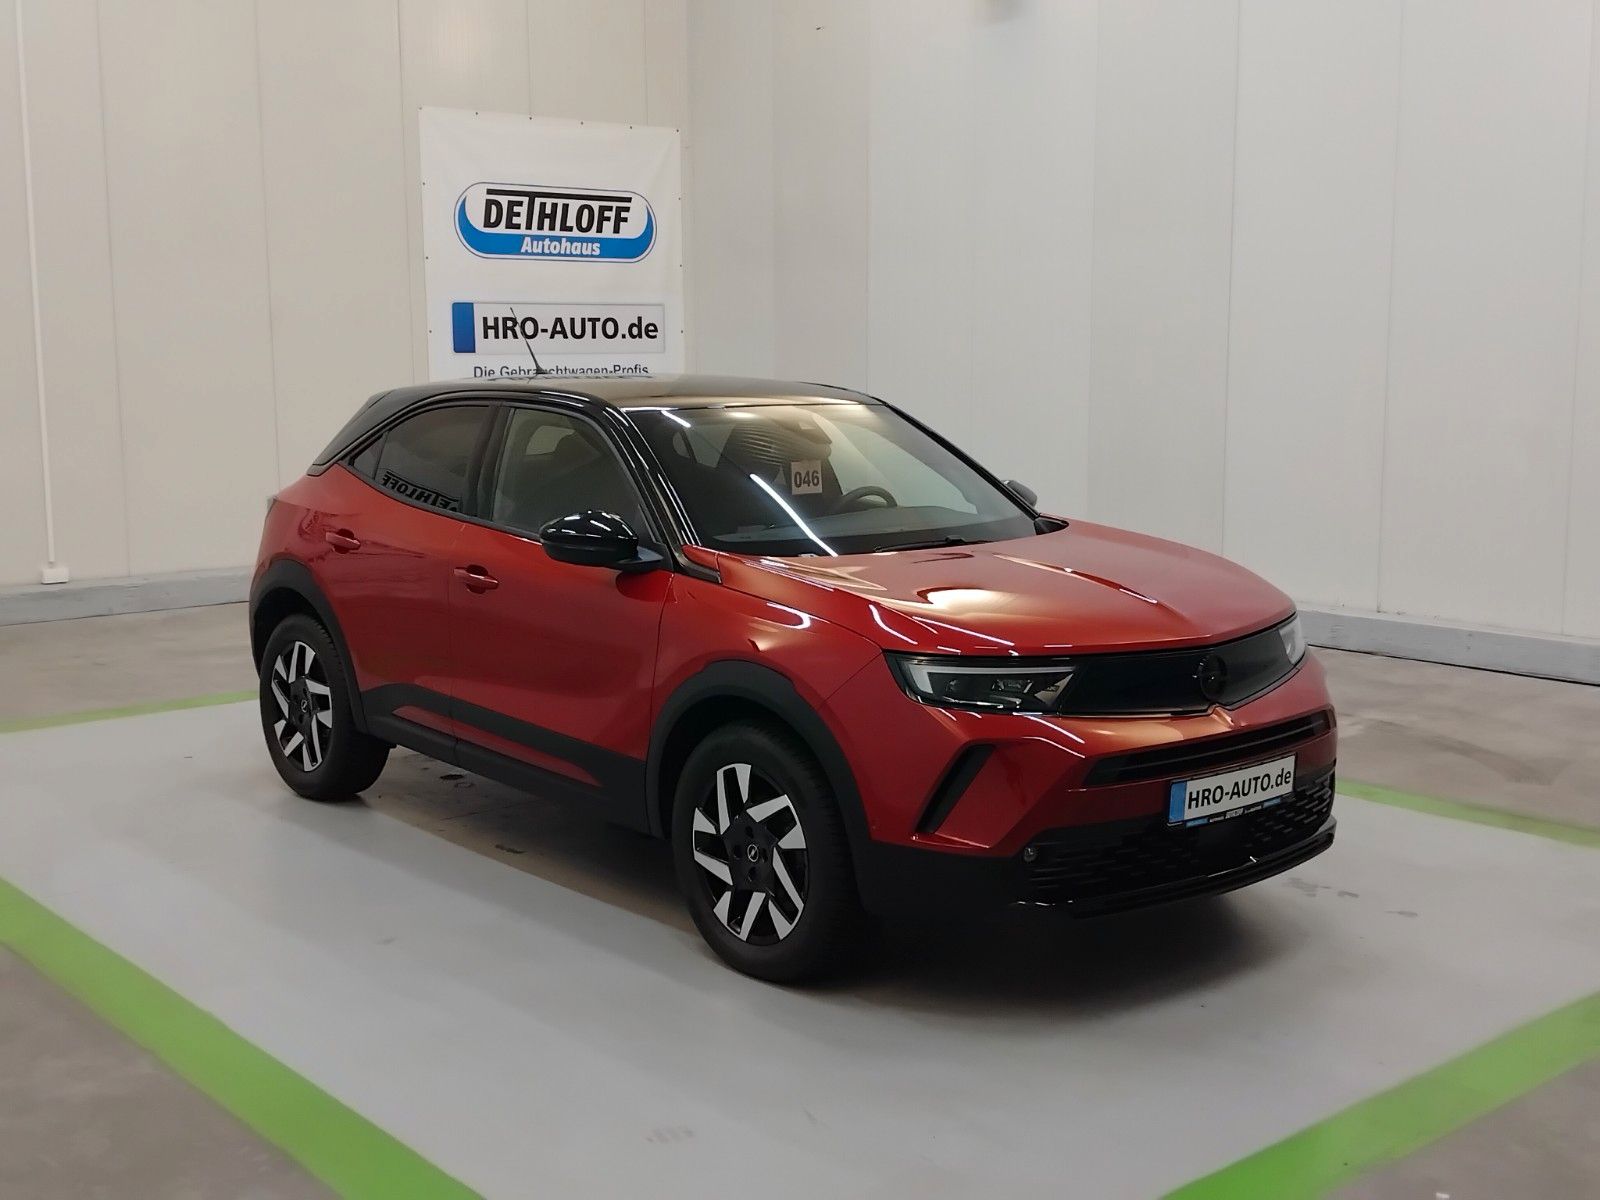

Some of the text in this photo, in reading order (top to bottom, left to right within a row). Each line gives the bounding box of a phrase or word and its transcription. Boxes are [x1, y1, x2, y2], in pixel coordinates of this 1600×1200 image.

[483, 188, 633, 234] DETHLOFF
[520, 236, 601, 256] Autohaus
[482, 316, 659, 340] HRO-AUTO.de
[473, 363, 649, 378] Die Gebrchtwagen-Profis
[793, 469, 820, 488] 046
[1187, 767, 1292, 810] HRO-AUTO.de
